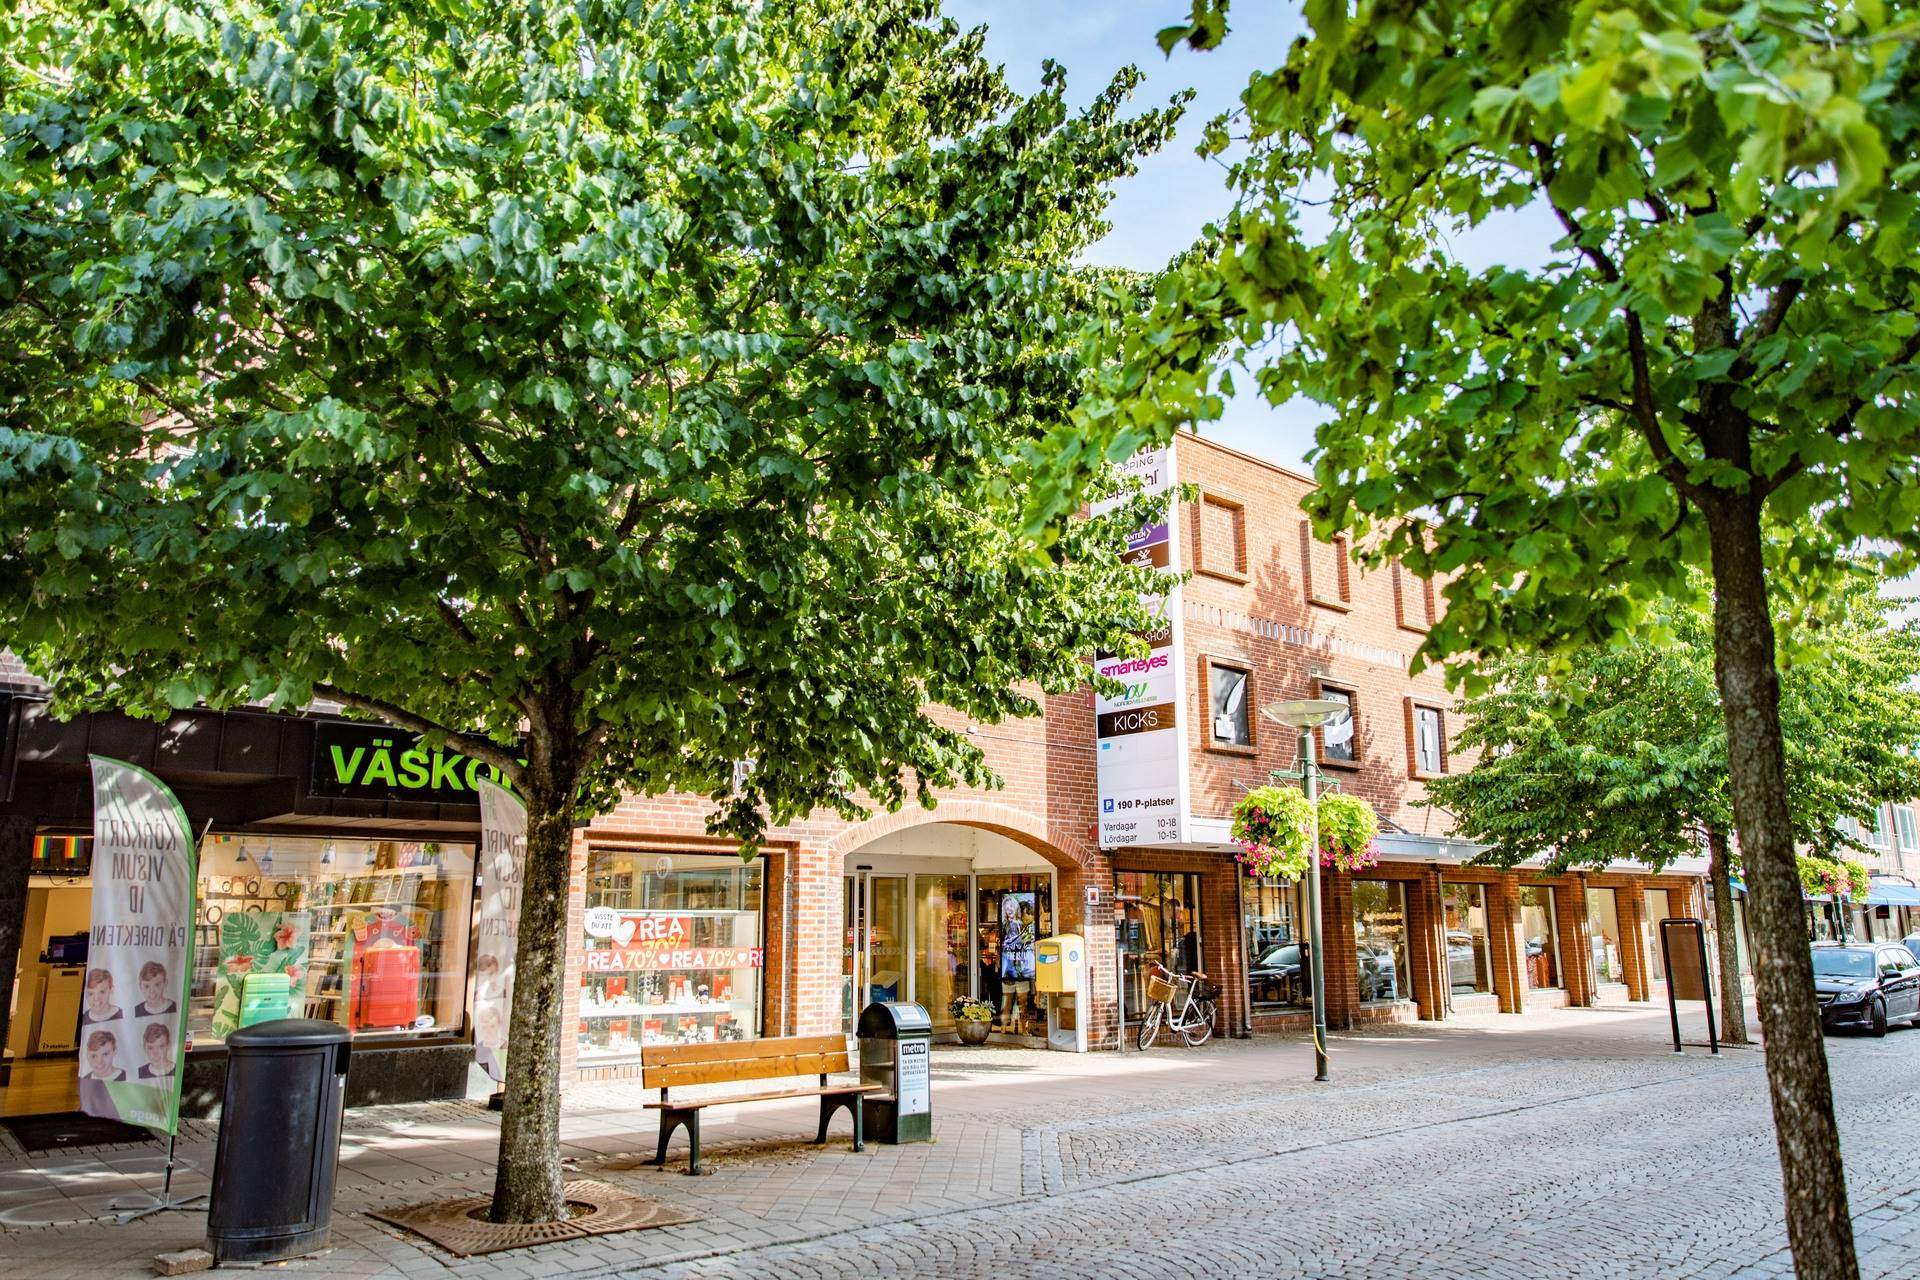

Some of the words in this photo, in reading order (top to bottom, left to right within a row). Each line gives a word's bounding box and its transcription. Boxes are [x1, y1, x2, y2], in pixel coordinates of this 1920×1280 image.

[1101, 655, 1168, 677] smarteyes
[1114, 711, 1158, 732] KICKS
[330, 739, 528, 791] VÄSKO
[1117, 800, 1133, 810] 190
[1135, 797, 1175, 809] P-platser
[1104, 822, 1137, 832] Vardagar
[1157, 818, 1177, 828] 10-18
[1104, 834, 1137, 844] Lördagar
[1157, 831, 1177, 841] 10-15
[640, 917, 684, 941] REA
[587, 951, 624, 970] REA
[625, 950, 658, 969] 70%
[672, 950, 705, 968] REA
[706, 950, 736, 968] 70%
[903, 1043, 925, 1054] metro
